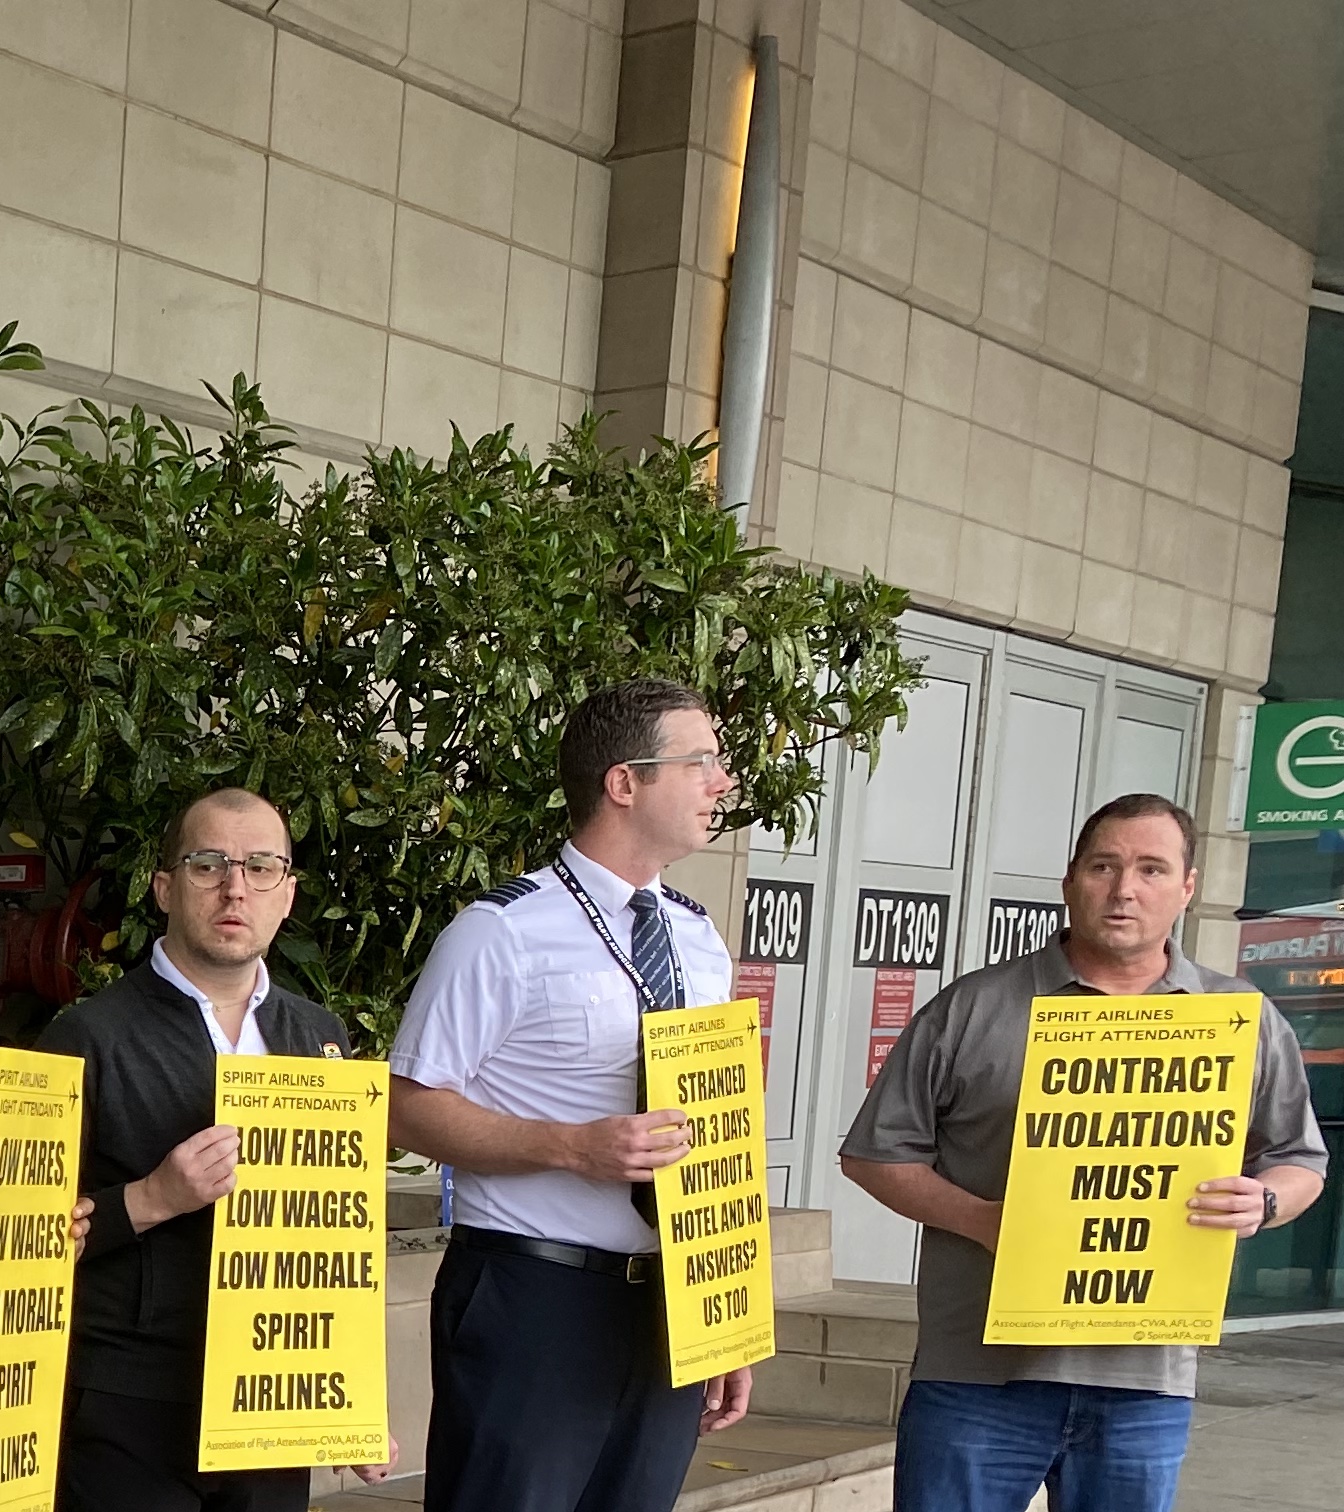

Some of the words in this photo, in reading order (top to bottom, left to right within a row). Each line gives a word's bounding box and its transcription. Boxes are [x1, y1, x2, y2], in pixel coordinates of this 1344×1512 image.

[1257, 810, 1328, 823] SMOKING
[748, 888, 803, 958] 1309
[858, 897, 940, 964] DT1309
[649, 1024, 686, 1039] SPIRIT
[689, 1018, 725, 1034] AIRLINES
[1034, 1031, 1096, 1042] FLIGHT
[1100, 1029, 1216, 1042] ATTENDANTS
[1036, 1011, 1091, 1023] SPIRIT
[1096, 1009, 1174, 1022] AIRLINES
[651, 1044, 691, 1060] FLIGHT
[693, 1036, 744, 1054] ATTENDANTS
[19, 1071, 48, 1089] AIRLINES
[223, 1071, 265, 1085] SPIRIT
[269, 1073, 325, 1087] AIRLINES
[678, 1064, 745, 1104] STRANDED
[1041, 1055, 1235, 1095] CONTRACT
[17, 1100, 63, 1118] ATTENDANTS
[223, 1095, 269, 1108] FLIGHT
[272, 1098, 357, 1111] ATTENDANTS
[682, 1117, 706, 1149] OR
[710, 1113, 718, 1144] 3
[722, 1107, 750, 1143] DAYS
[1025, 1110, 1236, 1148] VIOLATIONS
[21, 1140, 67, 1191] FARES,
[236, 1127, 287, 1166] LOW
[291, 1128, 368, 1172] FARES,
[680, 1153, 743, 1196] WITHOUT
[745, 1151, 753, 1180] A
[1071, 1165, 1179, 1201] MUST
[226, 1189, 276, 1227] LOW
[282, 1190, 374, 1233] WAGES,
[671, 1205, 718, 1244] HOTEL
[721, 1198, 745, 1233] AND
[748, 1193, 762, 1225] NO
[11, 1214, 67, 1263] WAGES,
[1080, 1217, 1150, 1252] END
[217, 1251, 269, 1290] LOW
[274, 1251, 378, 1293] MORALE,
[686, 1238, 757, 1287] ANSWERS?
[703, 1293, 722, 1327] US
[725, 1286, 747, 1321] TOO
[1063, 1269, 1154, 1304] NOW
[2, 1286, 65, 1336] MORALE,
[252, 1312, 334, 1351] SPIRIT
[232, 1372, 352, 1412] AIRLINES.
